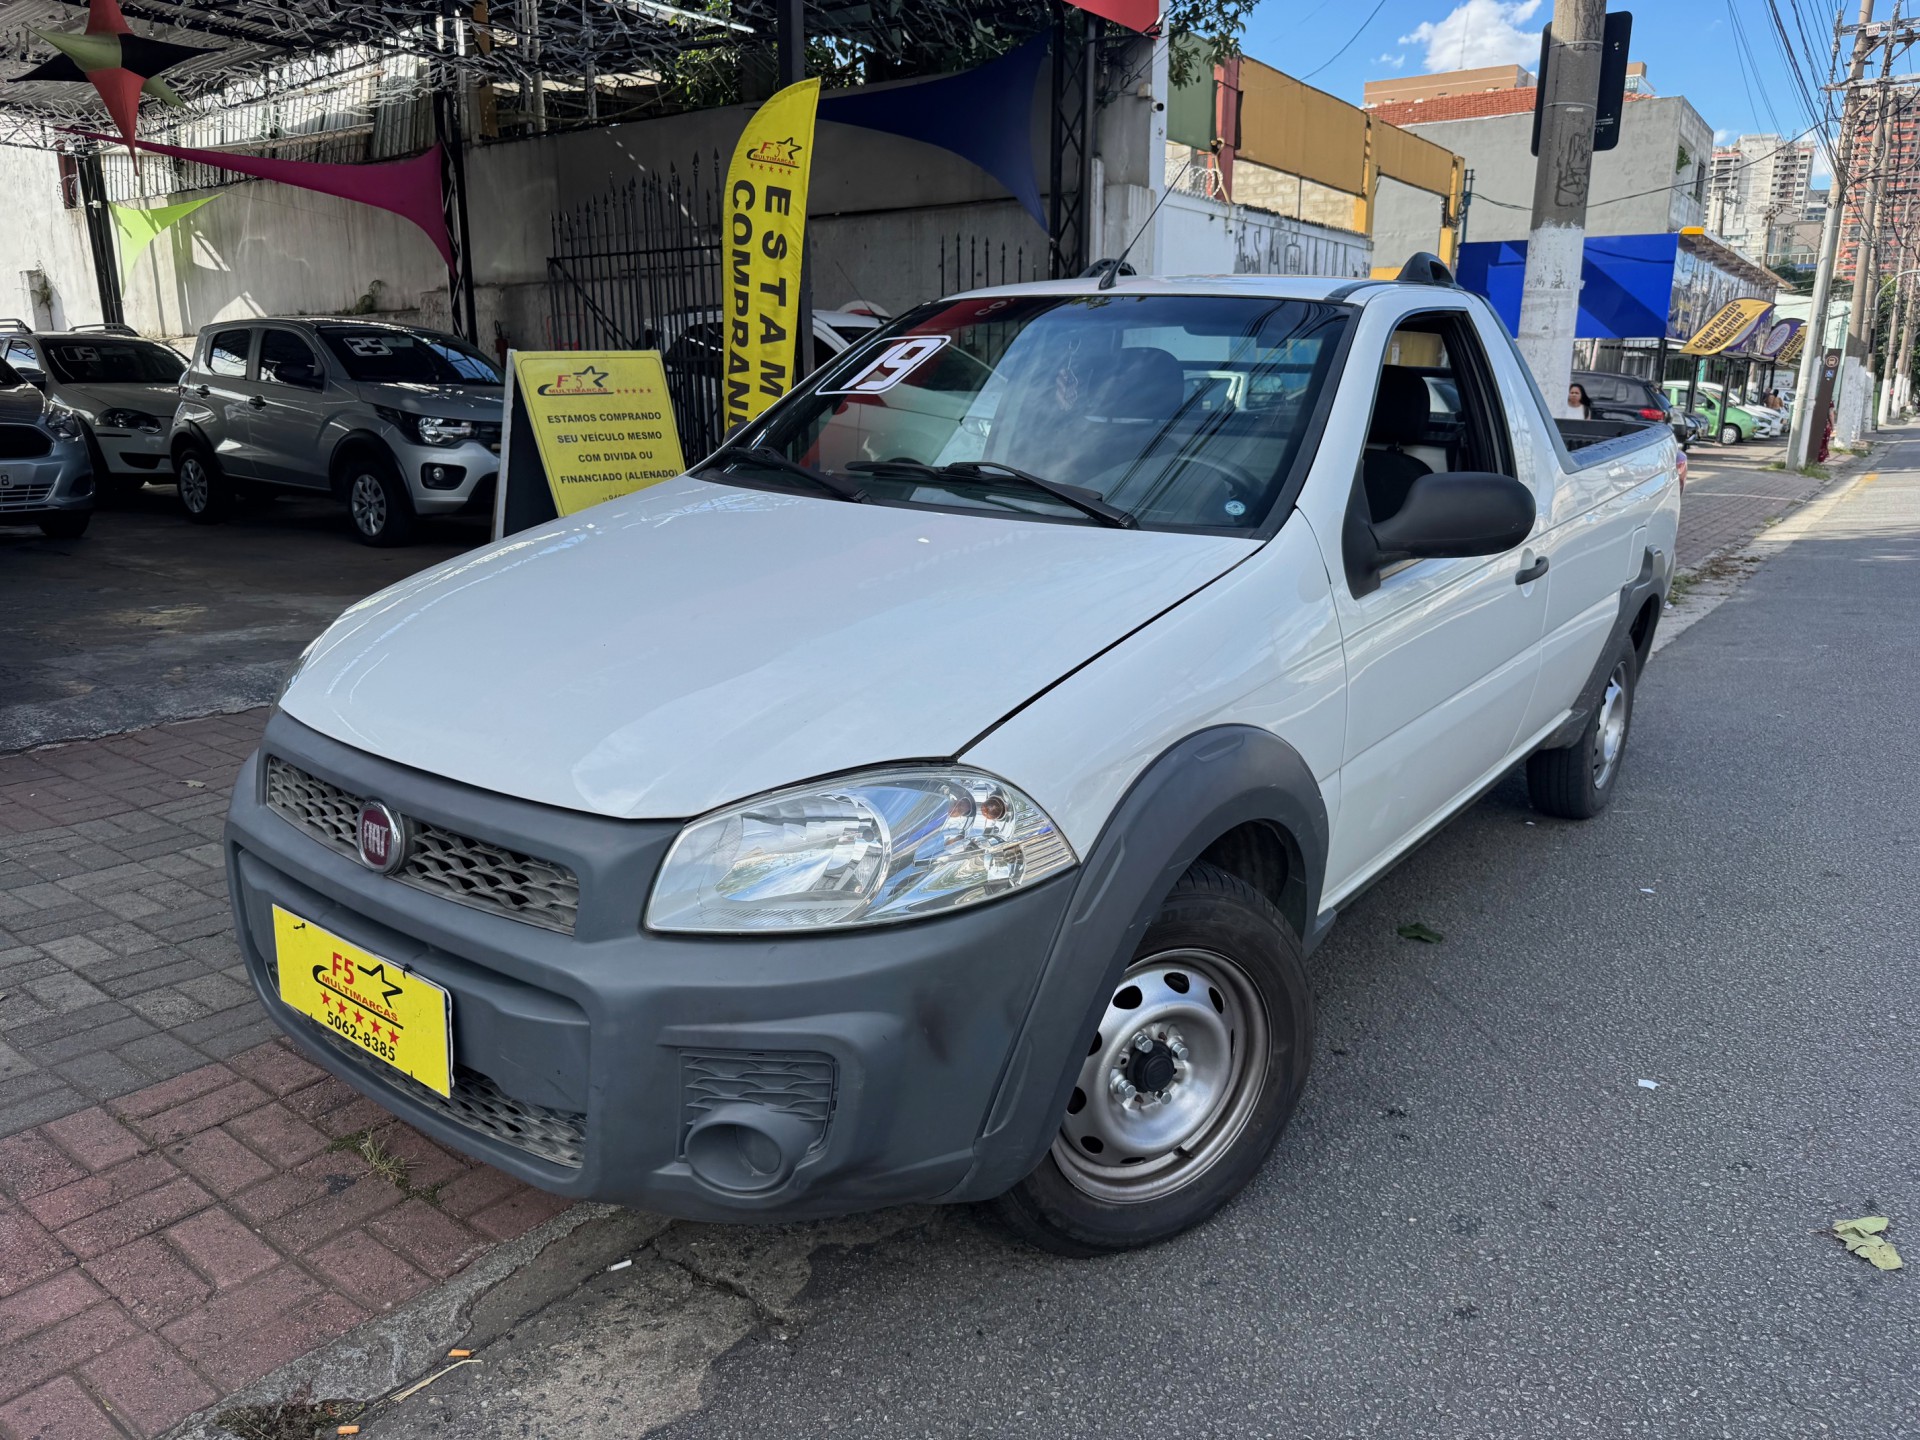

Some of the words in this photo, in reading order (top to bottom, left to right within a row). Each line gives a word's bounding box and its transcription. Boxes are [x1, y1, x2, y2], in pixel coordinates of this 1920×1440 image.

[757, 184, 792, 416] ESTAM
[1693, 301, 1742, 349] COMPRAMOS
[74, 346, 98, 360] 15
[346, 338, 390, 354] 25
[1704, 336, 1720, 350] SEU
[840, 338, 942, 390] 19
[547, 413, 597, 424] ESTAMOS
[600, 411, 662, 422] COMPRANDO
[557, 434, 578, 444] SEU
[580, 431, 625, 442] VEÍCULO
[627, 431, 662, 441] MESMO
[578, 453, 601, 463] COM
[603, 451, 637, 461] DIVIDA
[639, 451, 653, 460] OU
[560, 472, 622, 484] FINANCIADO
[625, 469, 678, 482] (ALIENADO)
[364, 820, 388, 857] FIAT
[332, 951, 355, 985] F5
[322, 974, 398, 1022] MULTIMARCAS
[326, 1010, 396, 1062] 5062-8385
